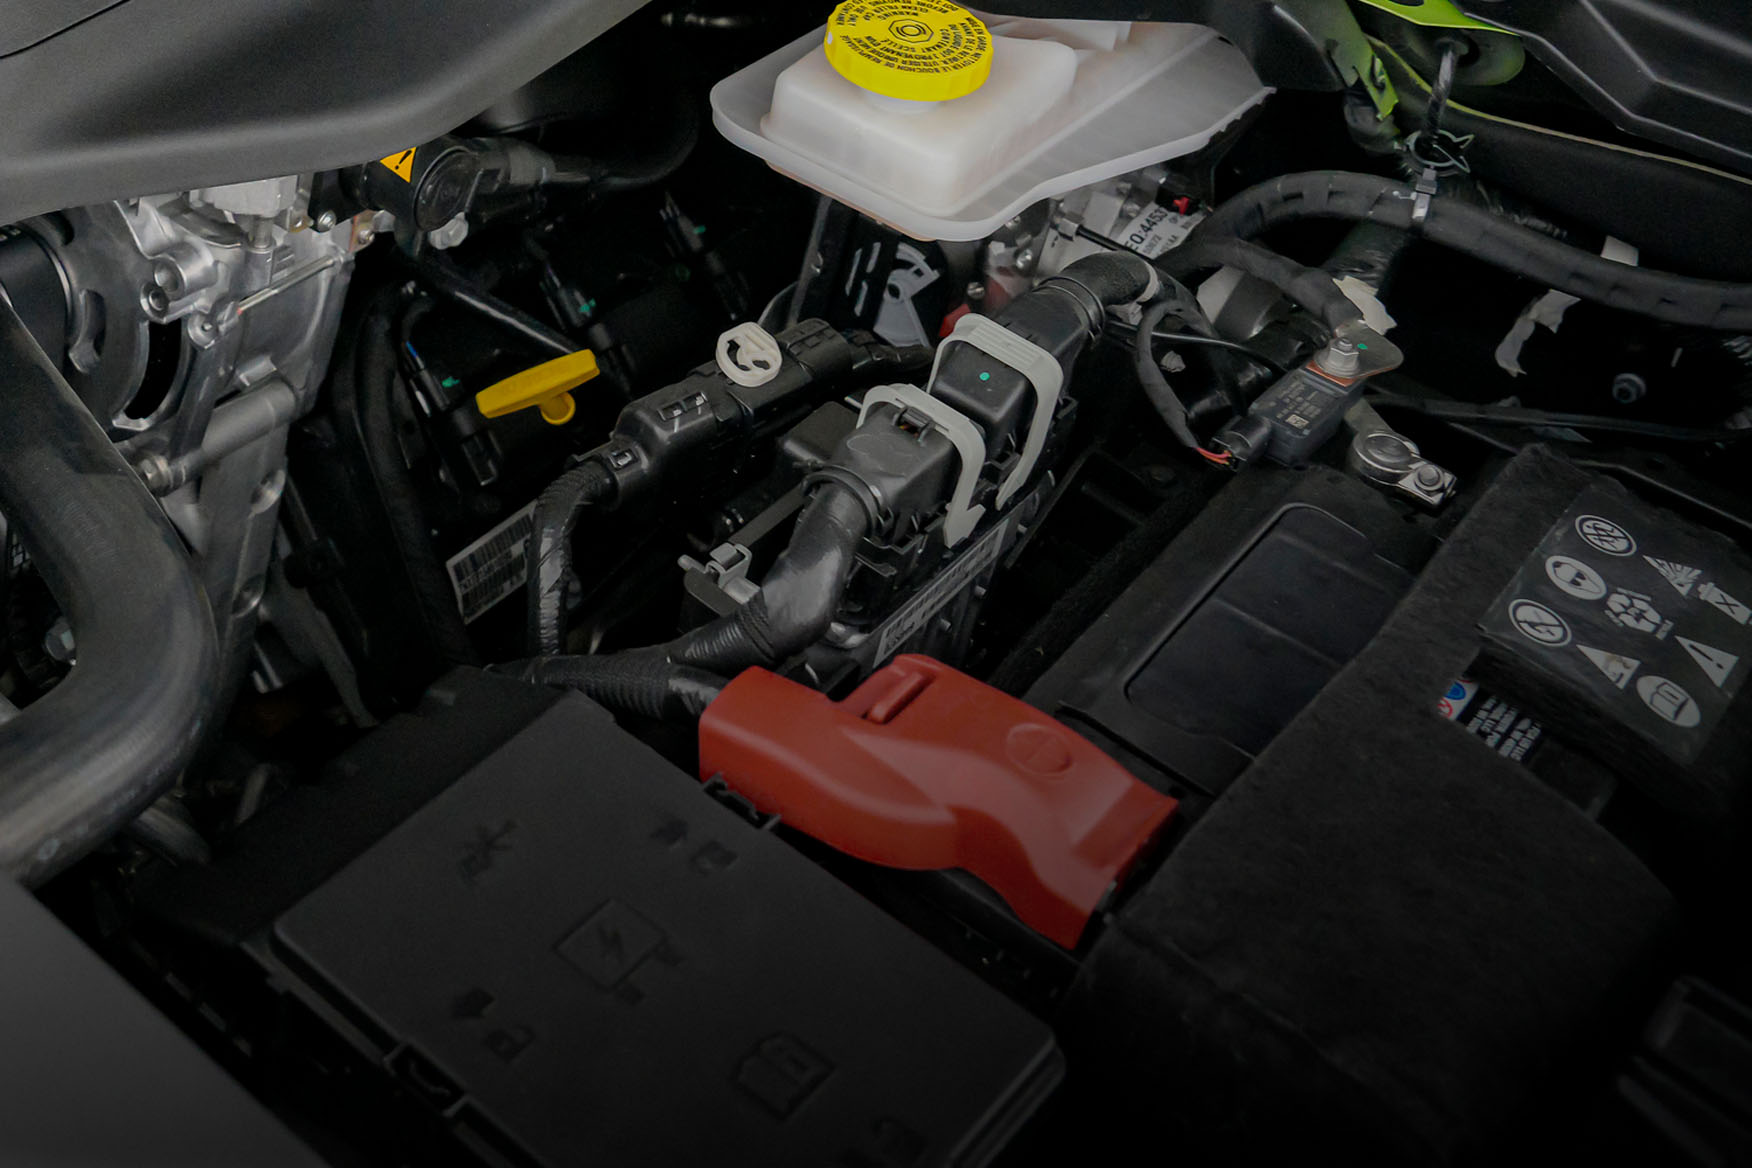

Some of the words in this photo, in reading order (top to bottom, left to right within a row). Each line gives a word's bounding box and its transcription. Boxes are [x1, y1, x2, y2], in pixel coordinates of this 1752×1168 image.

[873, 5, 898, 13] FILLER
[901, 5, 928, 13] CLEAN
[917, 1, 949, 13] BEFORE
[942, 3, 959, 11] DOT
[863, 13, 874, 21] CAP
[878, 11, 918, 20] WARNING
[921, 28, 950, 53] CONTENANT
[880, 46, 933, 60] PROVENANT
[940, 48, 955, 57] DOT
[897, 65, 940, 73] BOUCHON
